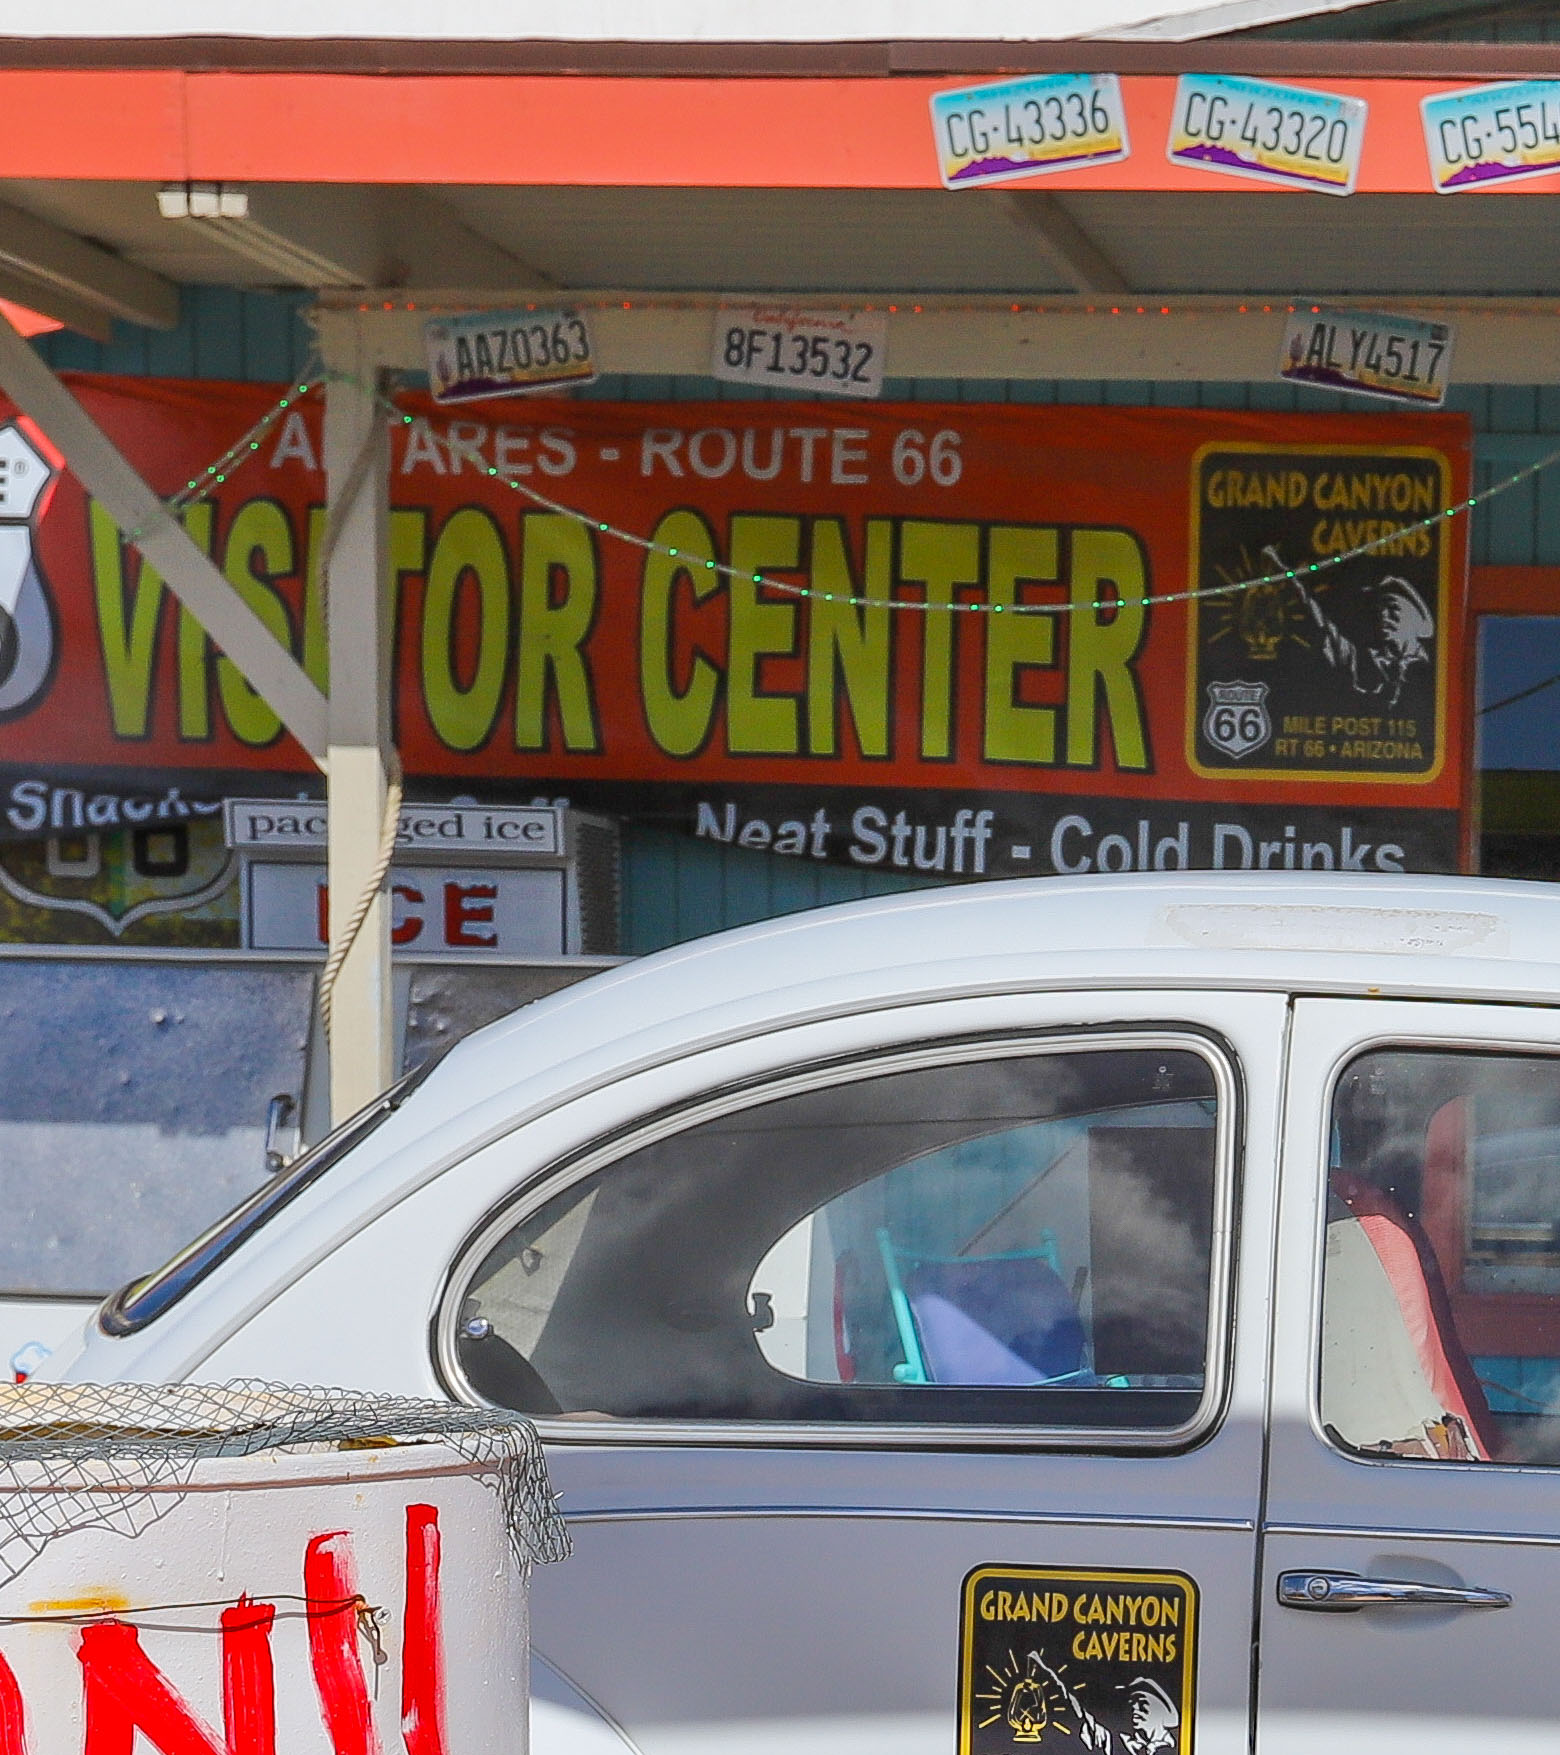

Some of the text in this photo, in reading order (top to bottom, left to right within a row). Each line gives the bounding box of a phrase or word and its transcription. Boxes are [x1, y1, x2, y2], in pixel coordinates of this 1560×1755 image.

[455, 320, 591, 383] AAZ0363
[723, 326, 875, 384] 8F13532
[1306, 322, 1445, 385] ALY4517
[269, 411, 579, 477] AARES
[641, 426, 870, 487] ROUTE
[892, 428, 964, 487] 66
[1207, 470, 1435, 513] GRAND CANYON
[1311, 519, 1431, 558] CAVERNS
[643, 507, 1150, 772] CENTER
[1213, 707, 1263, 743] 66
[1283, 716, 1326, 735] MILE
[1331, 717, 1381, 738] POST
[1340, 740, 1423, 761] ARIZONA
[248, 813, 546, 842] pacged ice
[848, 805, 994, 875] Stuff
[1050, 815, 1189, 873] Cold
[980, 1590, 1180, 1627] GRAND CANYON
[1072, 1630, 1177, 1663] CAVERNS
